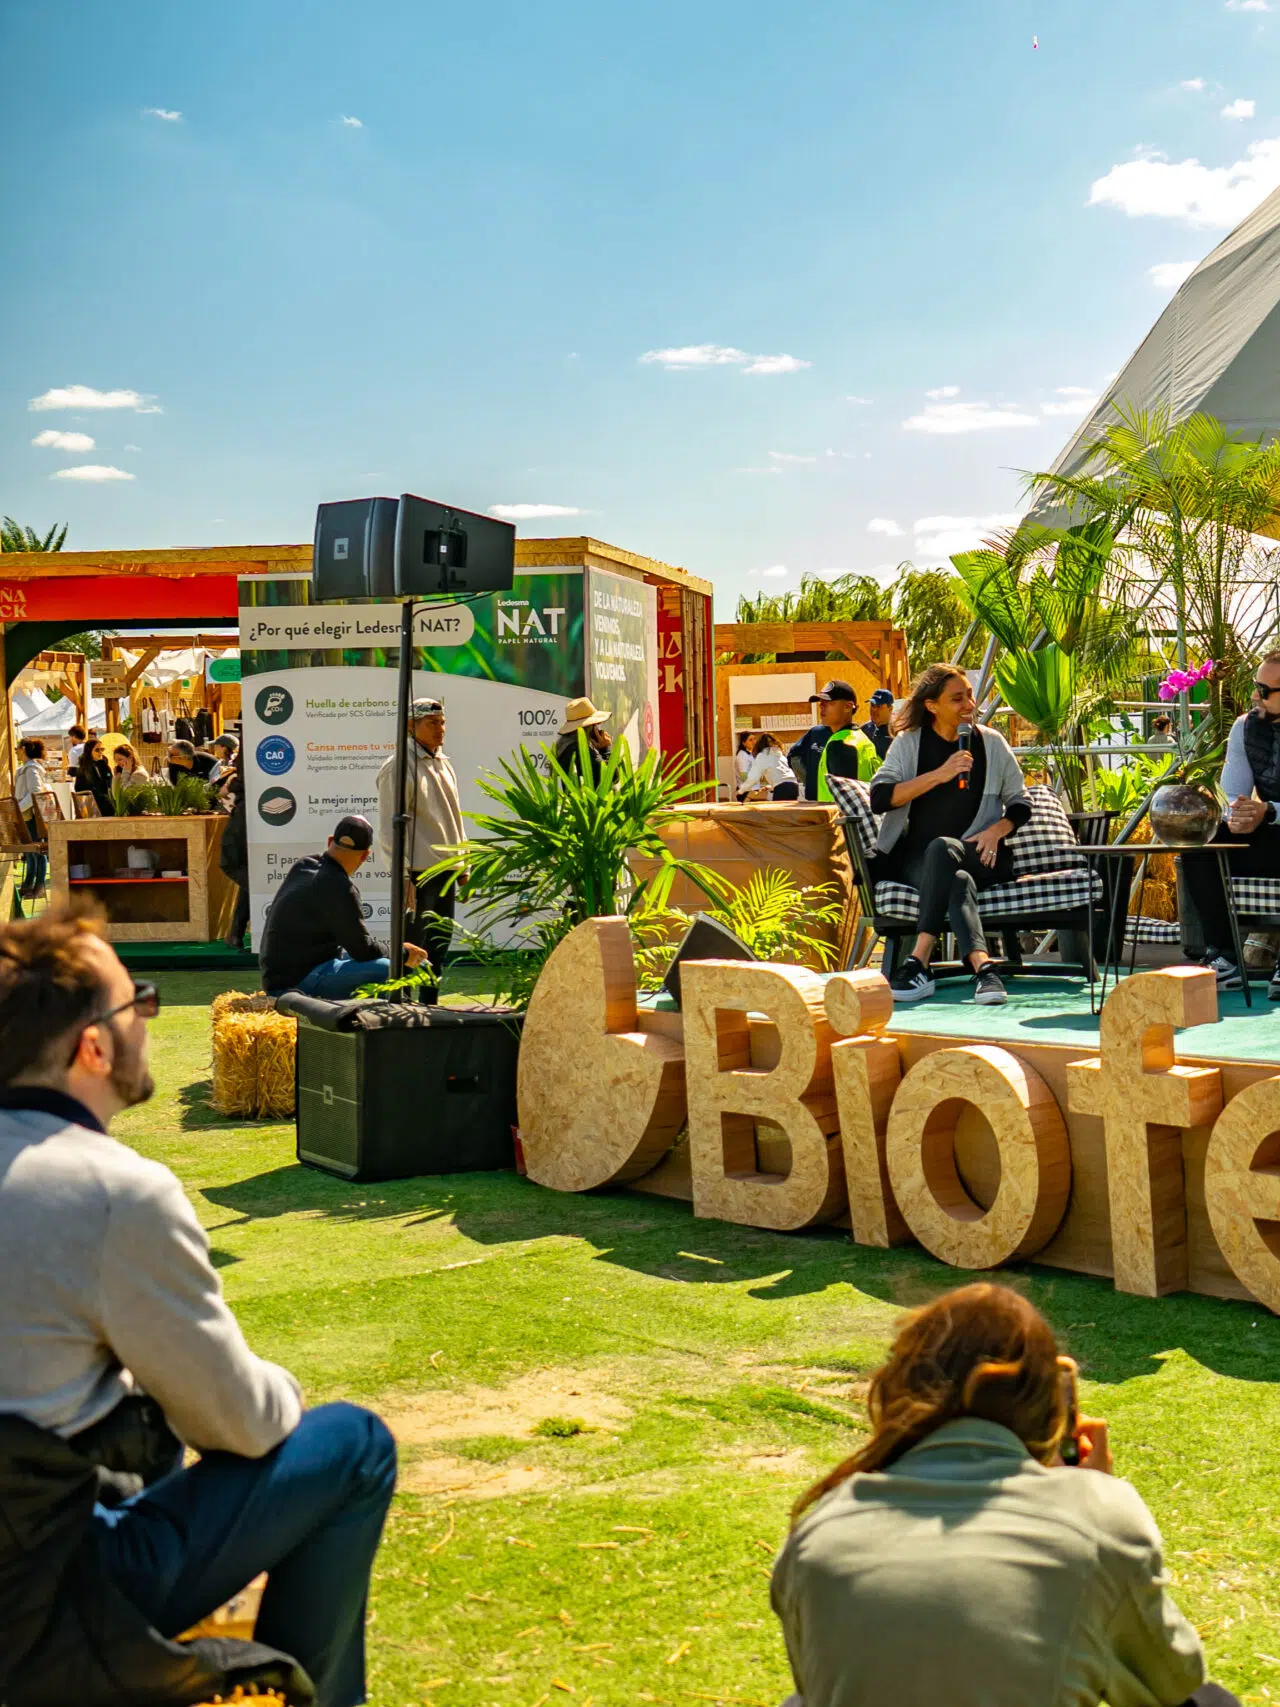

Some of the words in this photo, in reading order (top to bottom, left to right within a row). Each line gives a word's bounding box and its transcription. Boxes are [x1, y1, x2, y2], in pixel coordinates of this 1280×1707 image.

[497, 599, 529, 607] Ledesma
[497, 607, 566, 636] NAT
[250, 622, 281, 642] ¿Por
[284, 621, 310, 640] qué
[313, 620, 352, 640] elegir
[420, 618, 461, 633] NAT?
[306, 698, 336, 708] Huella
[339, 697, 350, 708] de
[352, 697, 390, 708] carbono
[518, 709, 558, 726] 100%
[306, 741, 335, 752] Cansa
[337, 743, 368, 751] menos
[308, 795, 319, 804] La
[322, 794, 348, 807] mejor
[319, 808, 333, 816] gran
[267, 853, 278, 865] El
